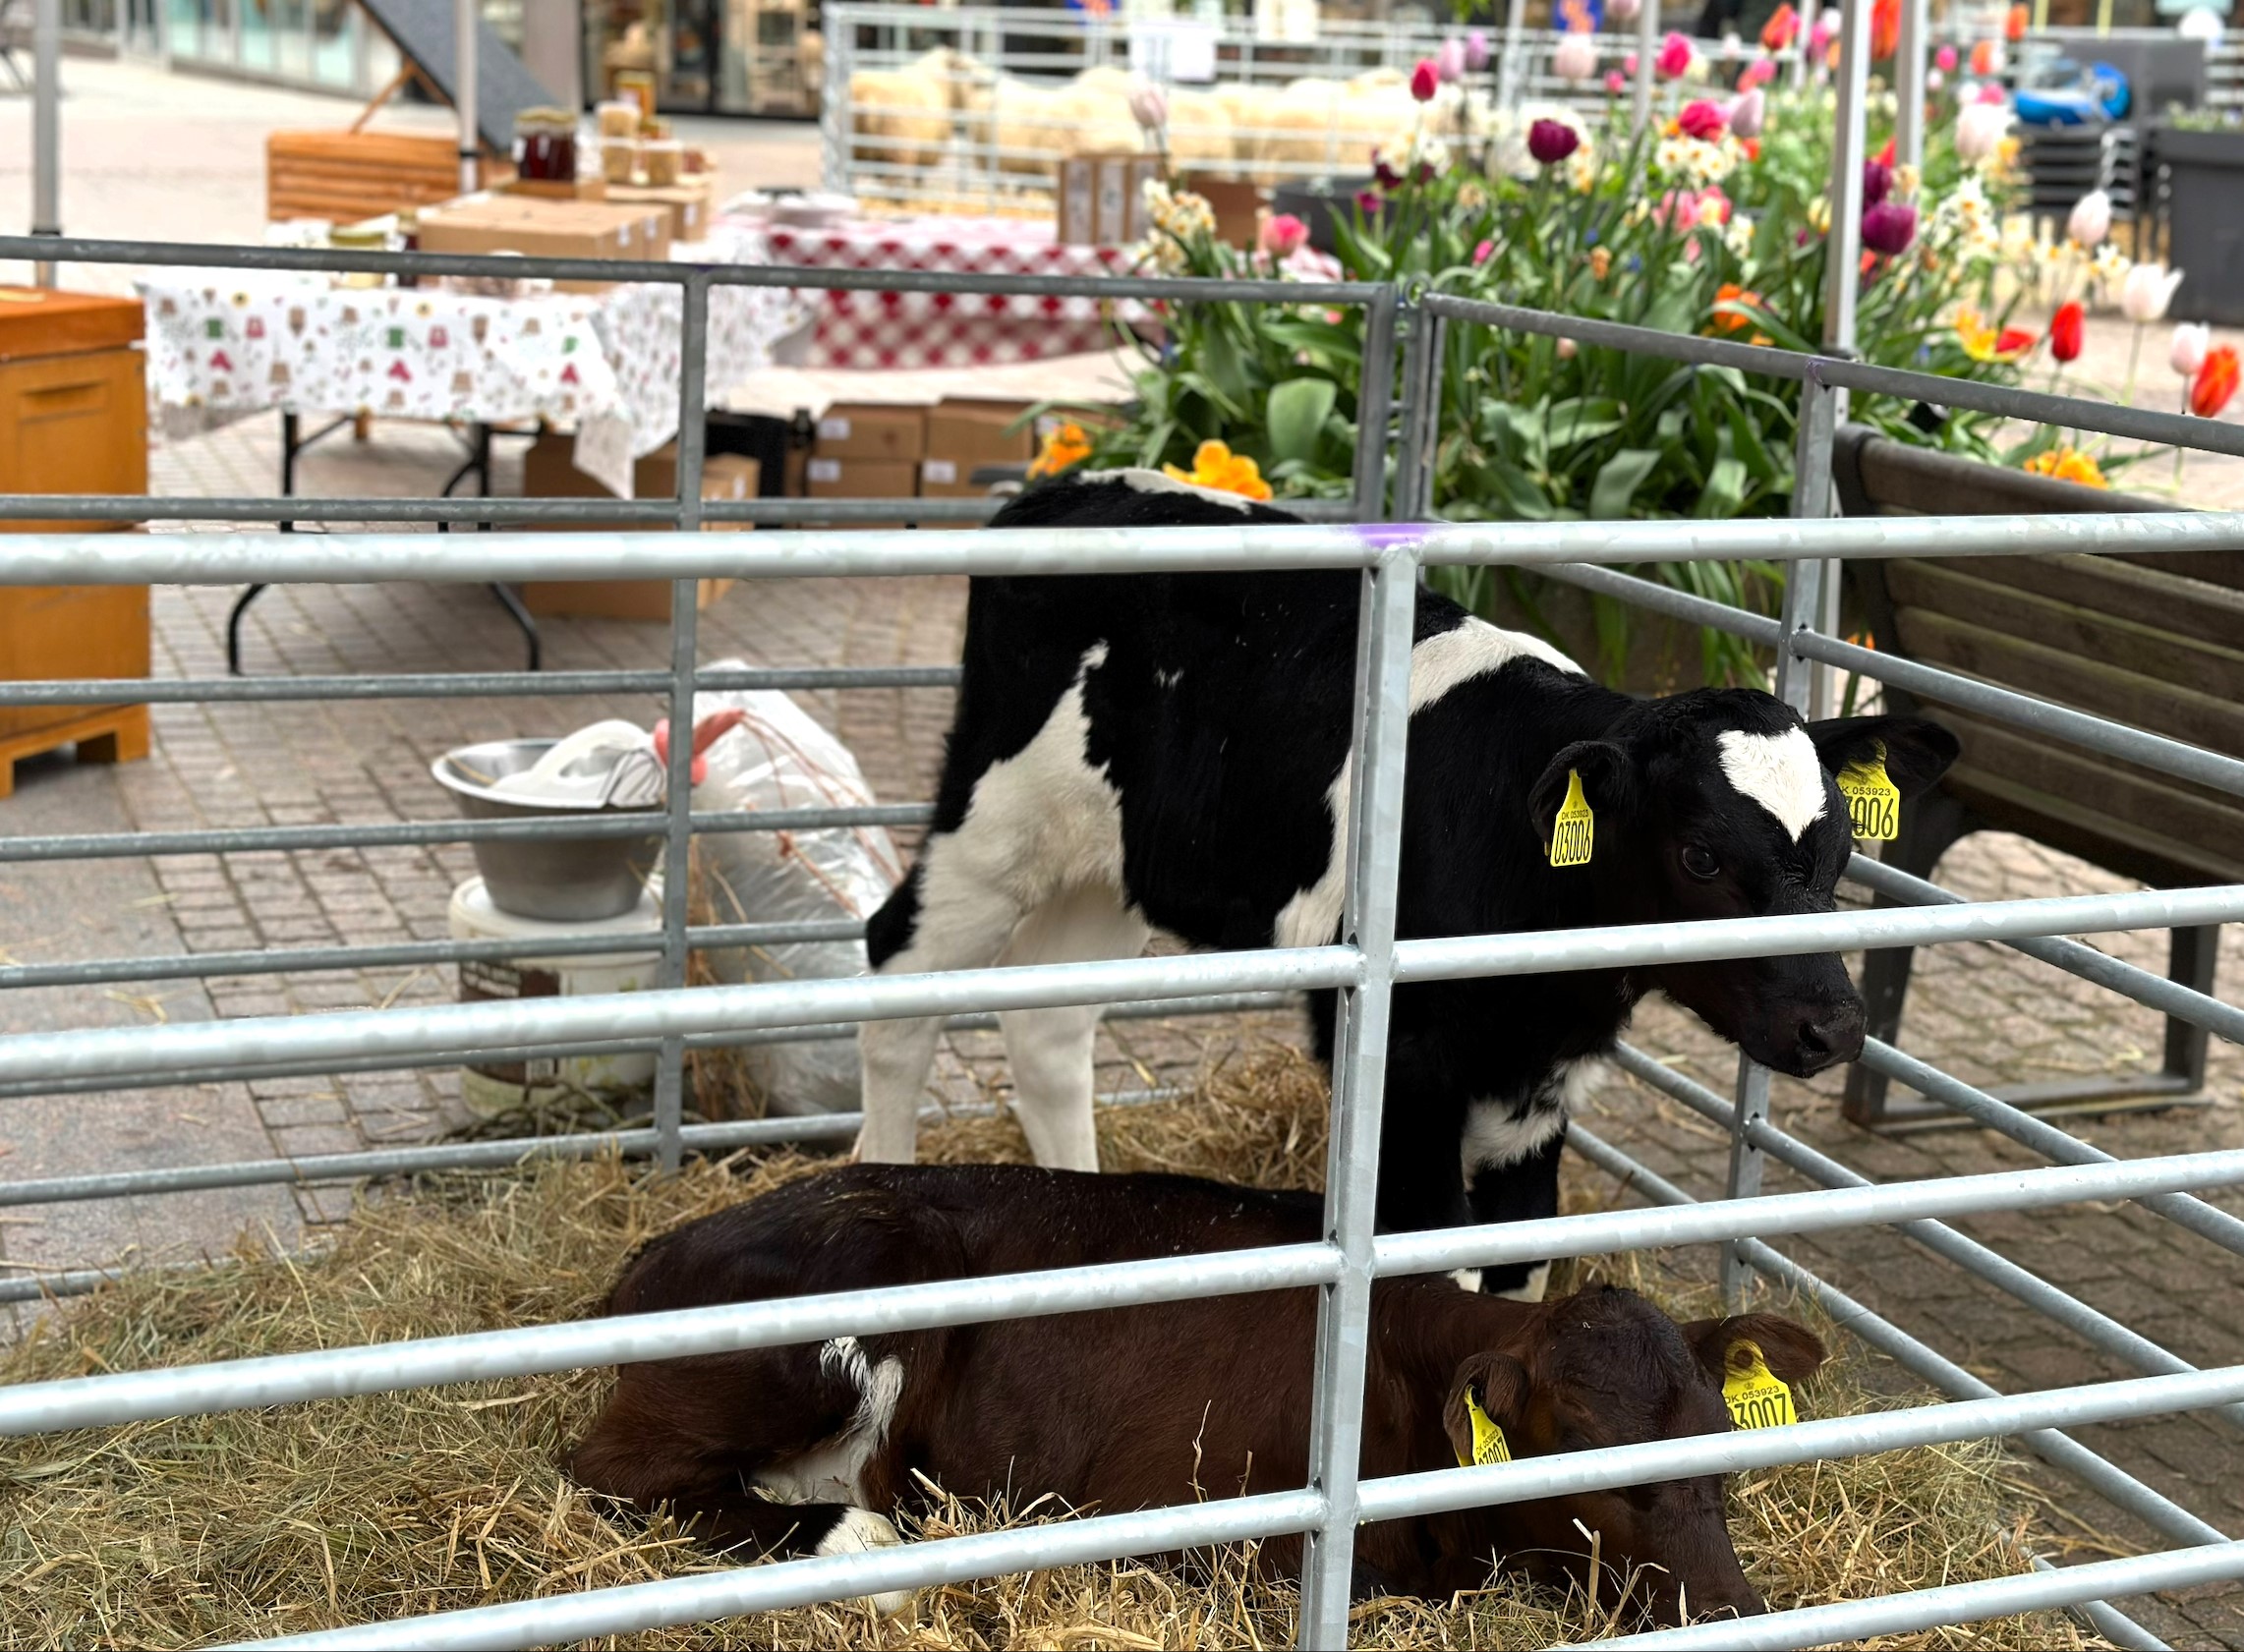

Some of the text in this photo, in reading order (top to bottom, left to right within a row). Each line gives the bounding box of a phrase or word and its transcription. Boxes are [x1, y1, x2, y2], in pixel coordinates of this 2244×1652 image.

[1852, 786, 1891, 797] 053923
[1562, 811, 1570, 821] DK
[1846, 796, 1894, 838] 006
[1554, 819, 1591, 865] 03006
[1742, 1385, 1780, 1400] 053923
[1734, 1393, 1786, 1430] 3007
